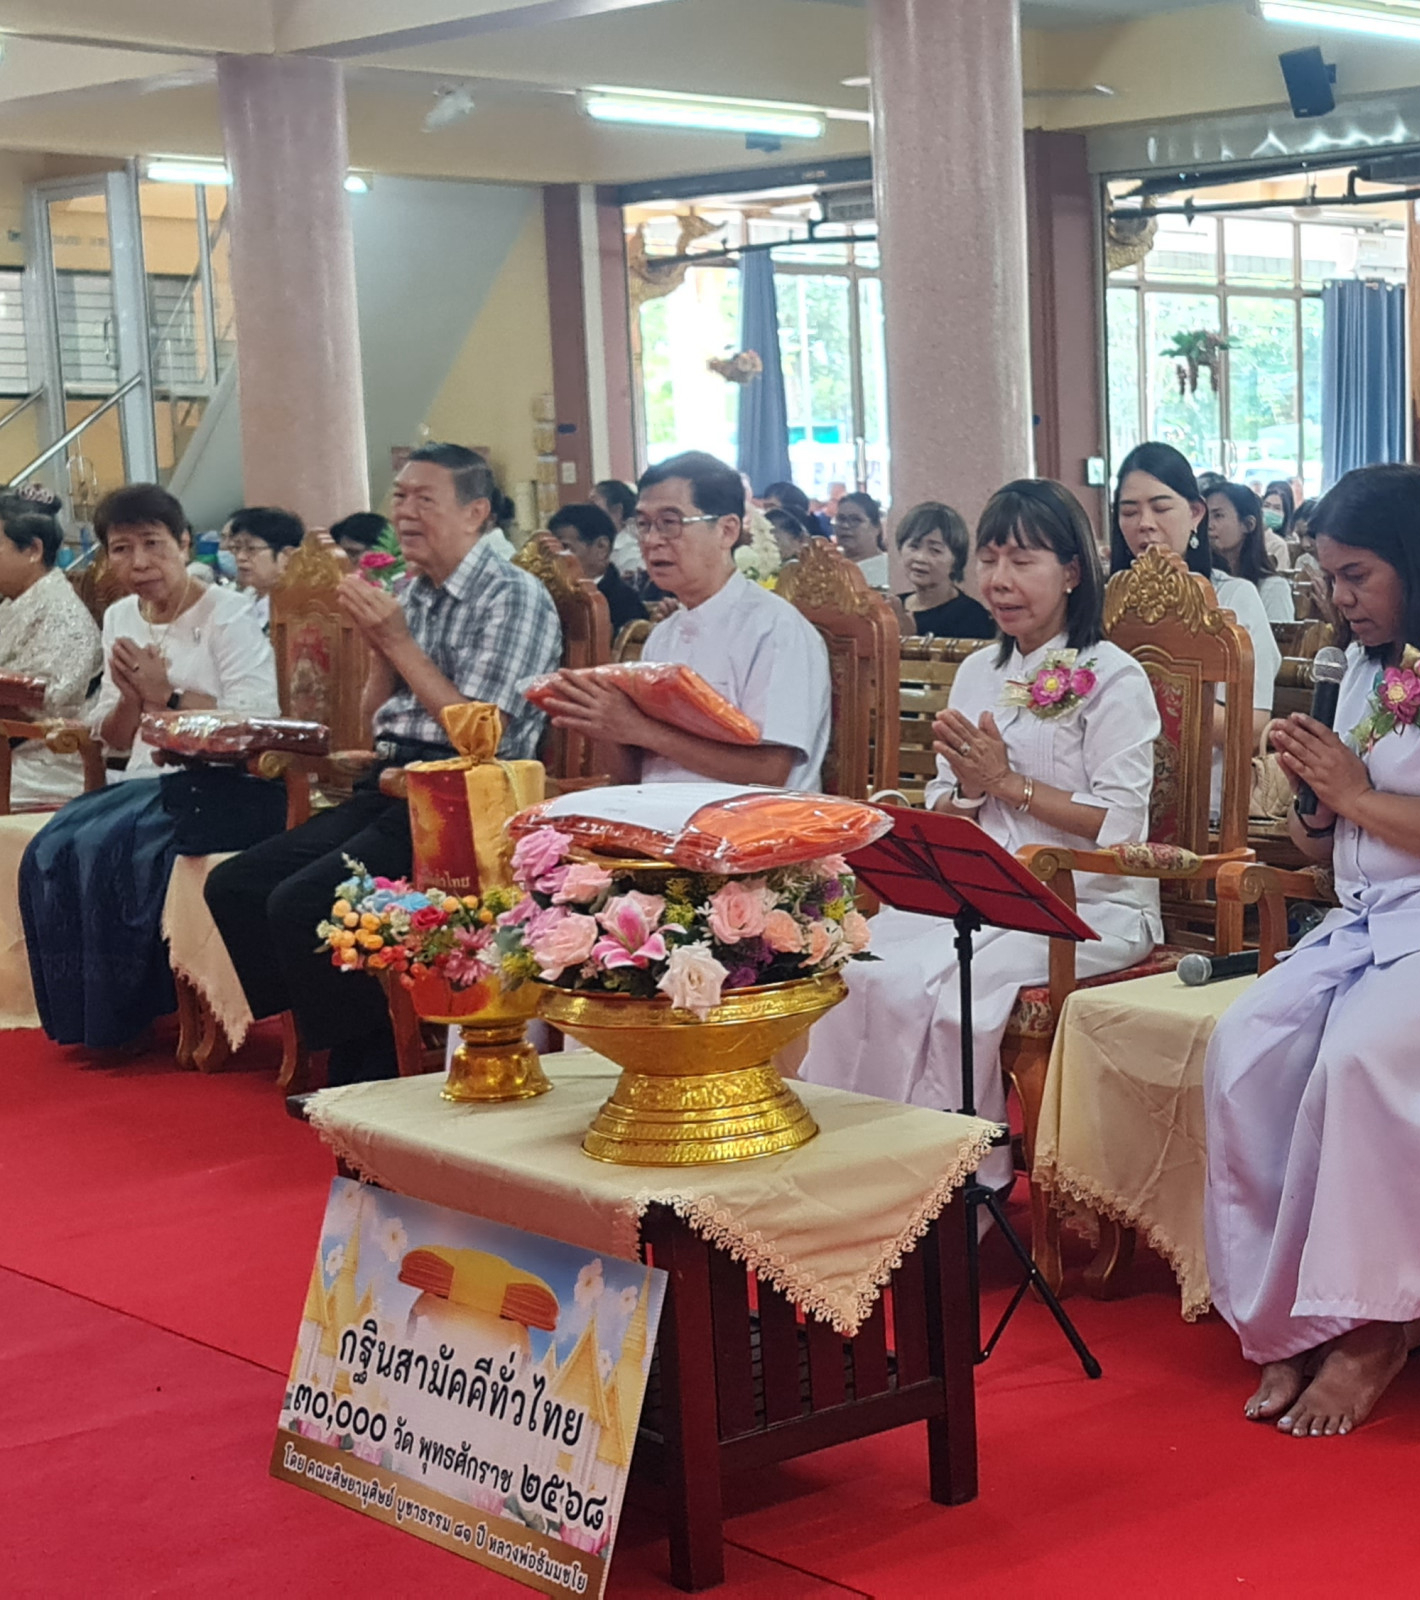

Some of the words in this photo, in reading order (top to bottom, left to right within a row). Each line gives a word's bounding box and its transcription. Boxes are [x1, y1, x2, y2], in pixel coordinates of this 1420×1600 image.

[339, 1318, 584, 1446] กฐินสามัคคีทั่วไทย
[284, 1442, 306, 1471] โดย
[307, 1464, 396, 1507] คณะศิษยานุศิษย์
[397, 1496, 452, 1532] บูชาธรรม
[453, 1523, 472, 1542] ๘๑
[476, 1523, 486, 1547] ปี
[488, 1535, 587, 1591] หลวงพ่อธัมมชโย
[293, 1383, 387, 1442] ๓๐,๐๐๐
[393, 1415, 414, 1454] วัด
[418, 1436, 513, 1493] พุทธศักราช
[520, 1463, 607, 1531] ๒๕๖๘
